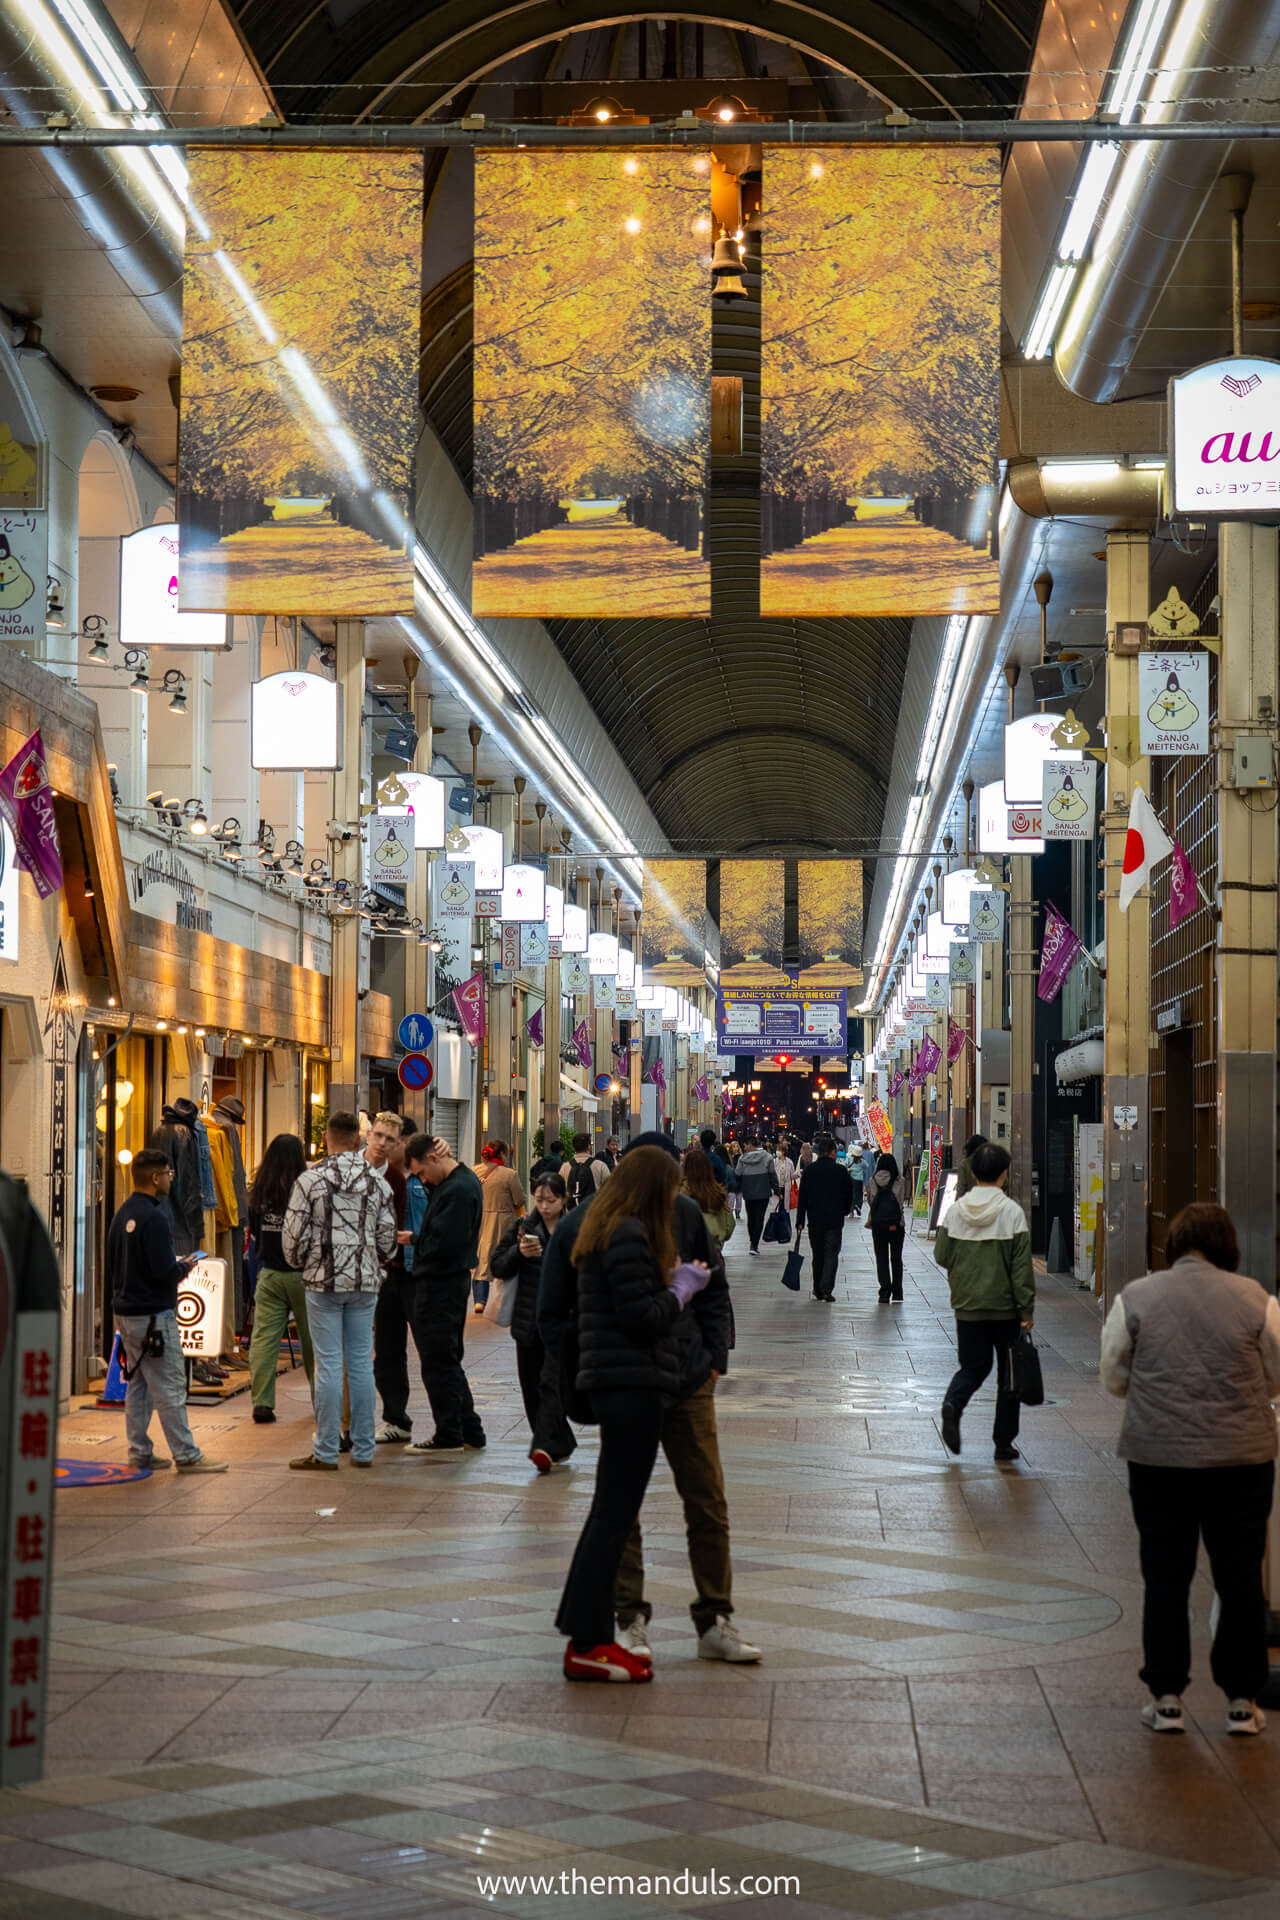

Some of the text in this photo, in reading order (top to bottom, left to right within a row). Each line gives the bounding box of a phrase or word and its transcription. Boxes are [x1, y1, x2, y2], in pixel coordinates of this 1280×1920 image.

[1201, 431, 1280, 464] au
[1157, 734, 1189, 742] SANJO
[1147, 743, 1199, 751] MEITENGAI
[1047, 829, 1088, 837] MEITENGAI
[504, 940, 515, 967] KICS
[1057, 1087, 1083, 1097] 免税店
